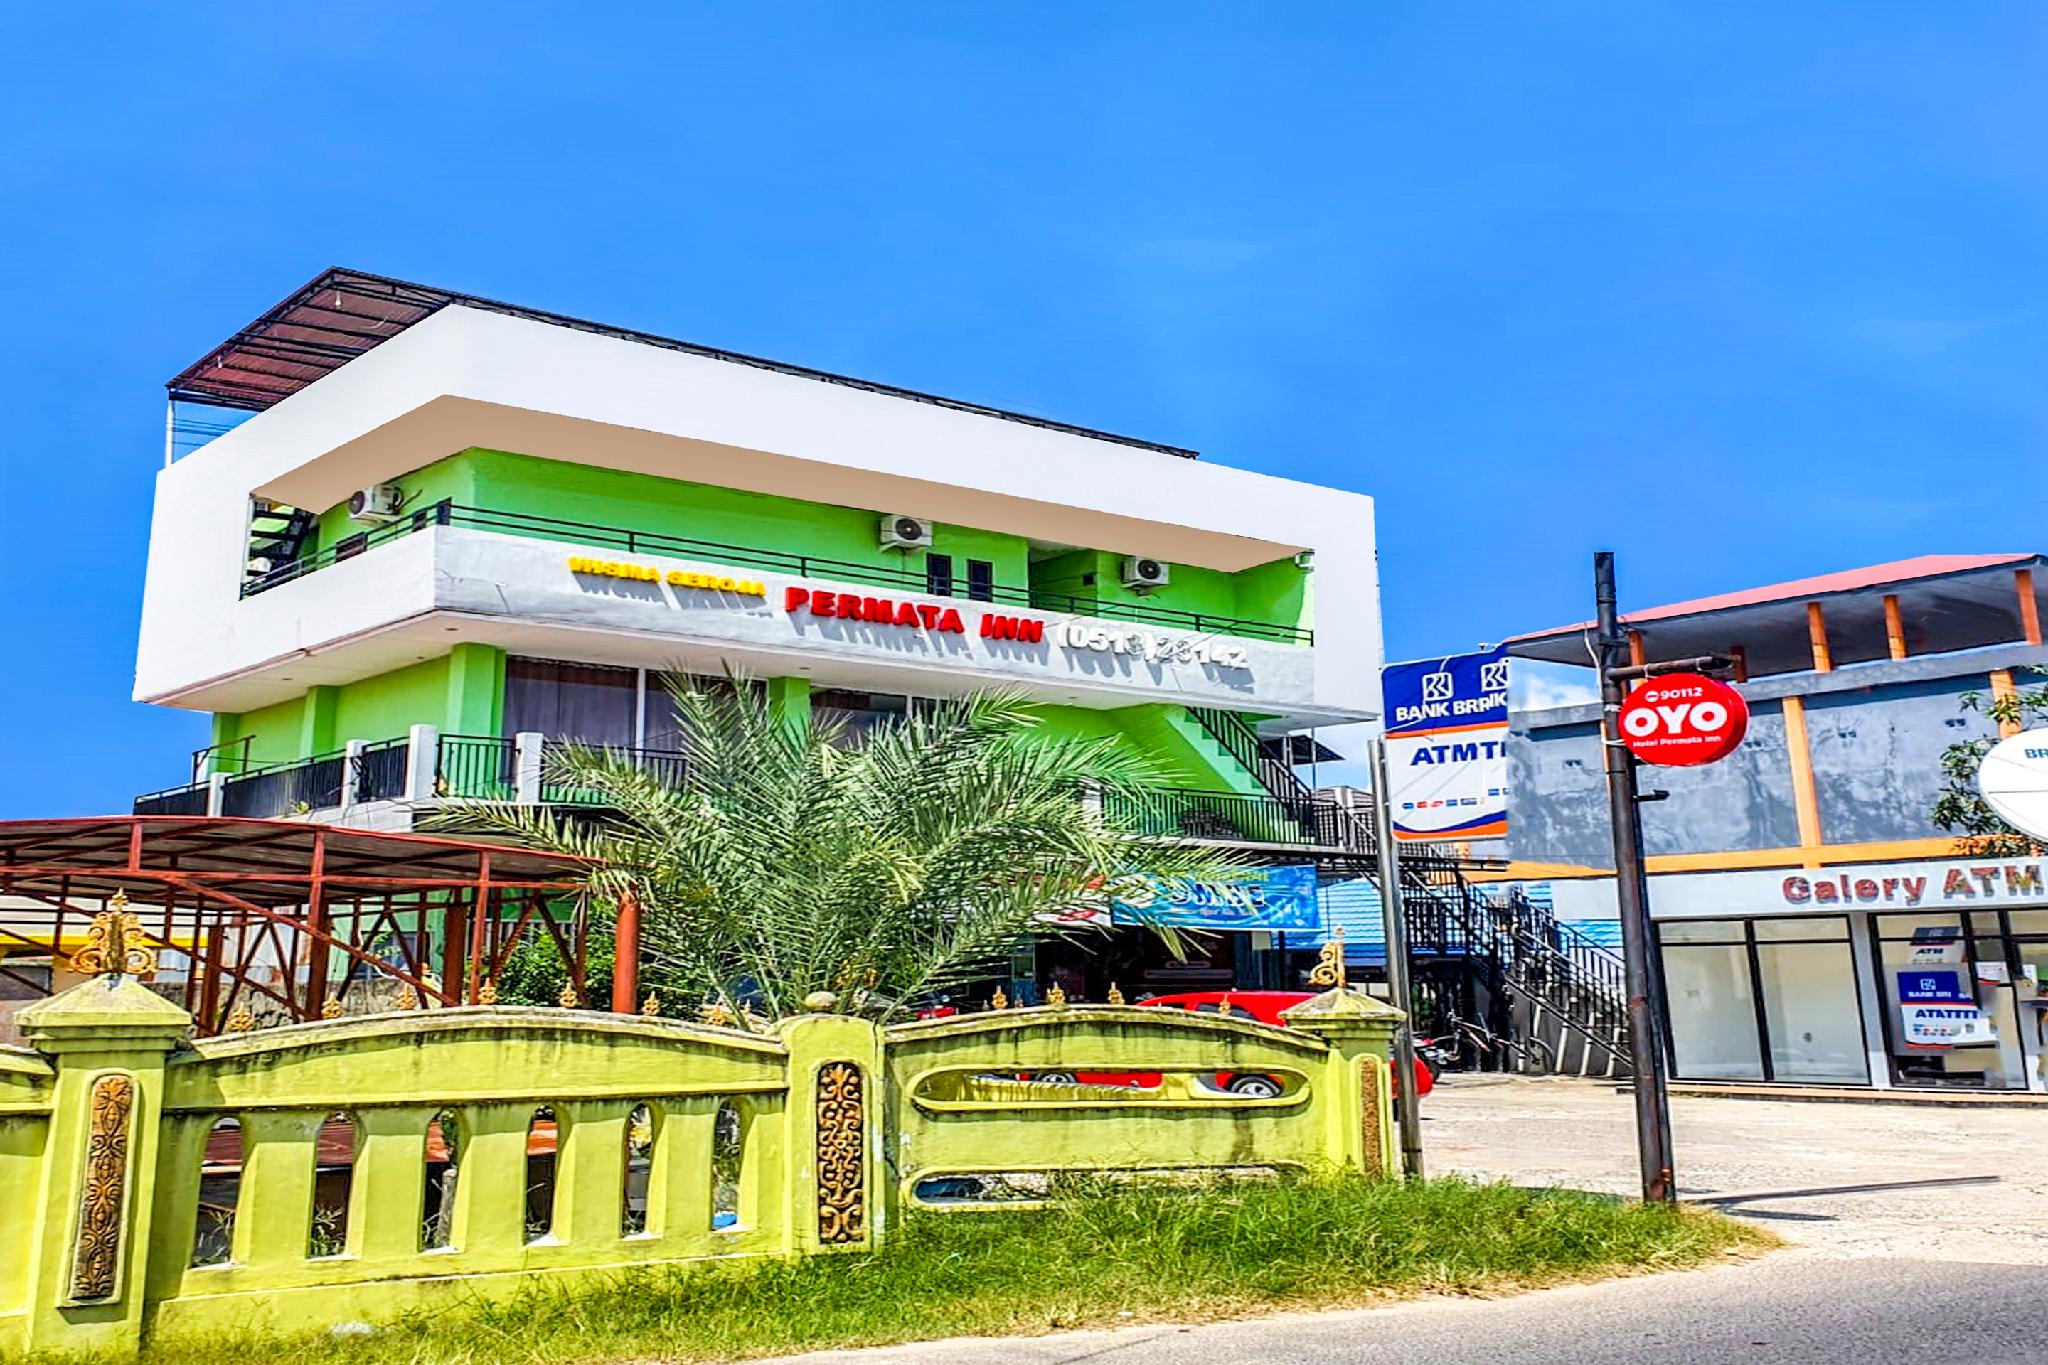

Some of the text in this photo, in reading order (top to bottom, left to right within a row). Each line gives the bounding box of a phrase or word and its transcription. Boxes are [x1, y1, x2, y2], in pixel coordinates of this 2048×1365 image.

[785, 586, 965, 634] PERMATA
[980, 613, 1044, 643] INN
[1659, 687, 1703, 700] 90112
[1395, 701, 1450, 722] BANK
[1623, 701, 1728, 737] OYO
[1632, 739, 1659, 747] Hotel
[1660, 736, 1703, 745] Permata
[1782, 865, 2045, 906] Galery ATM
